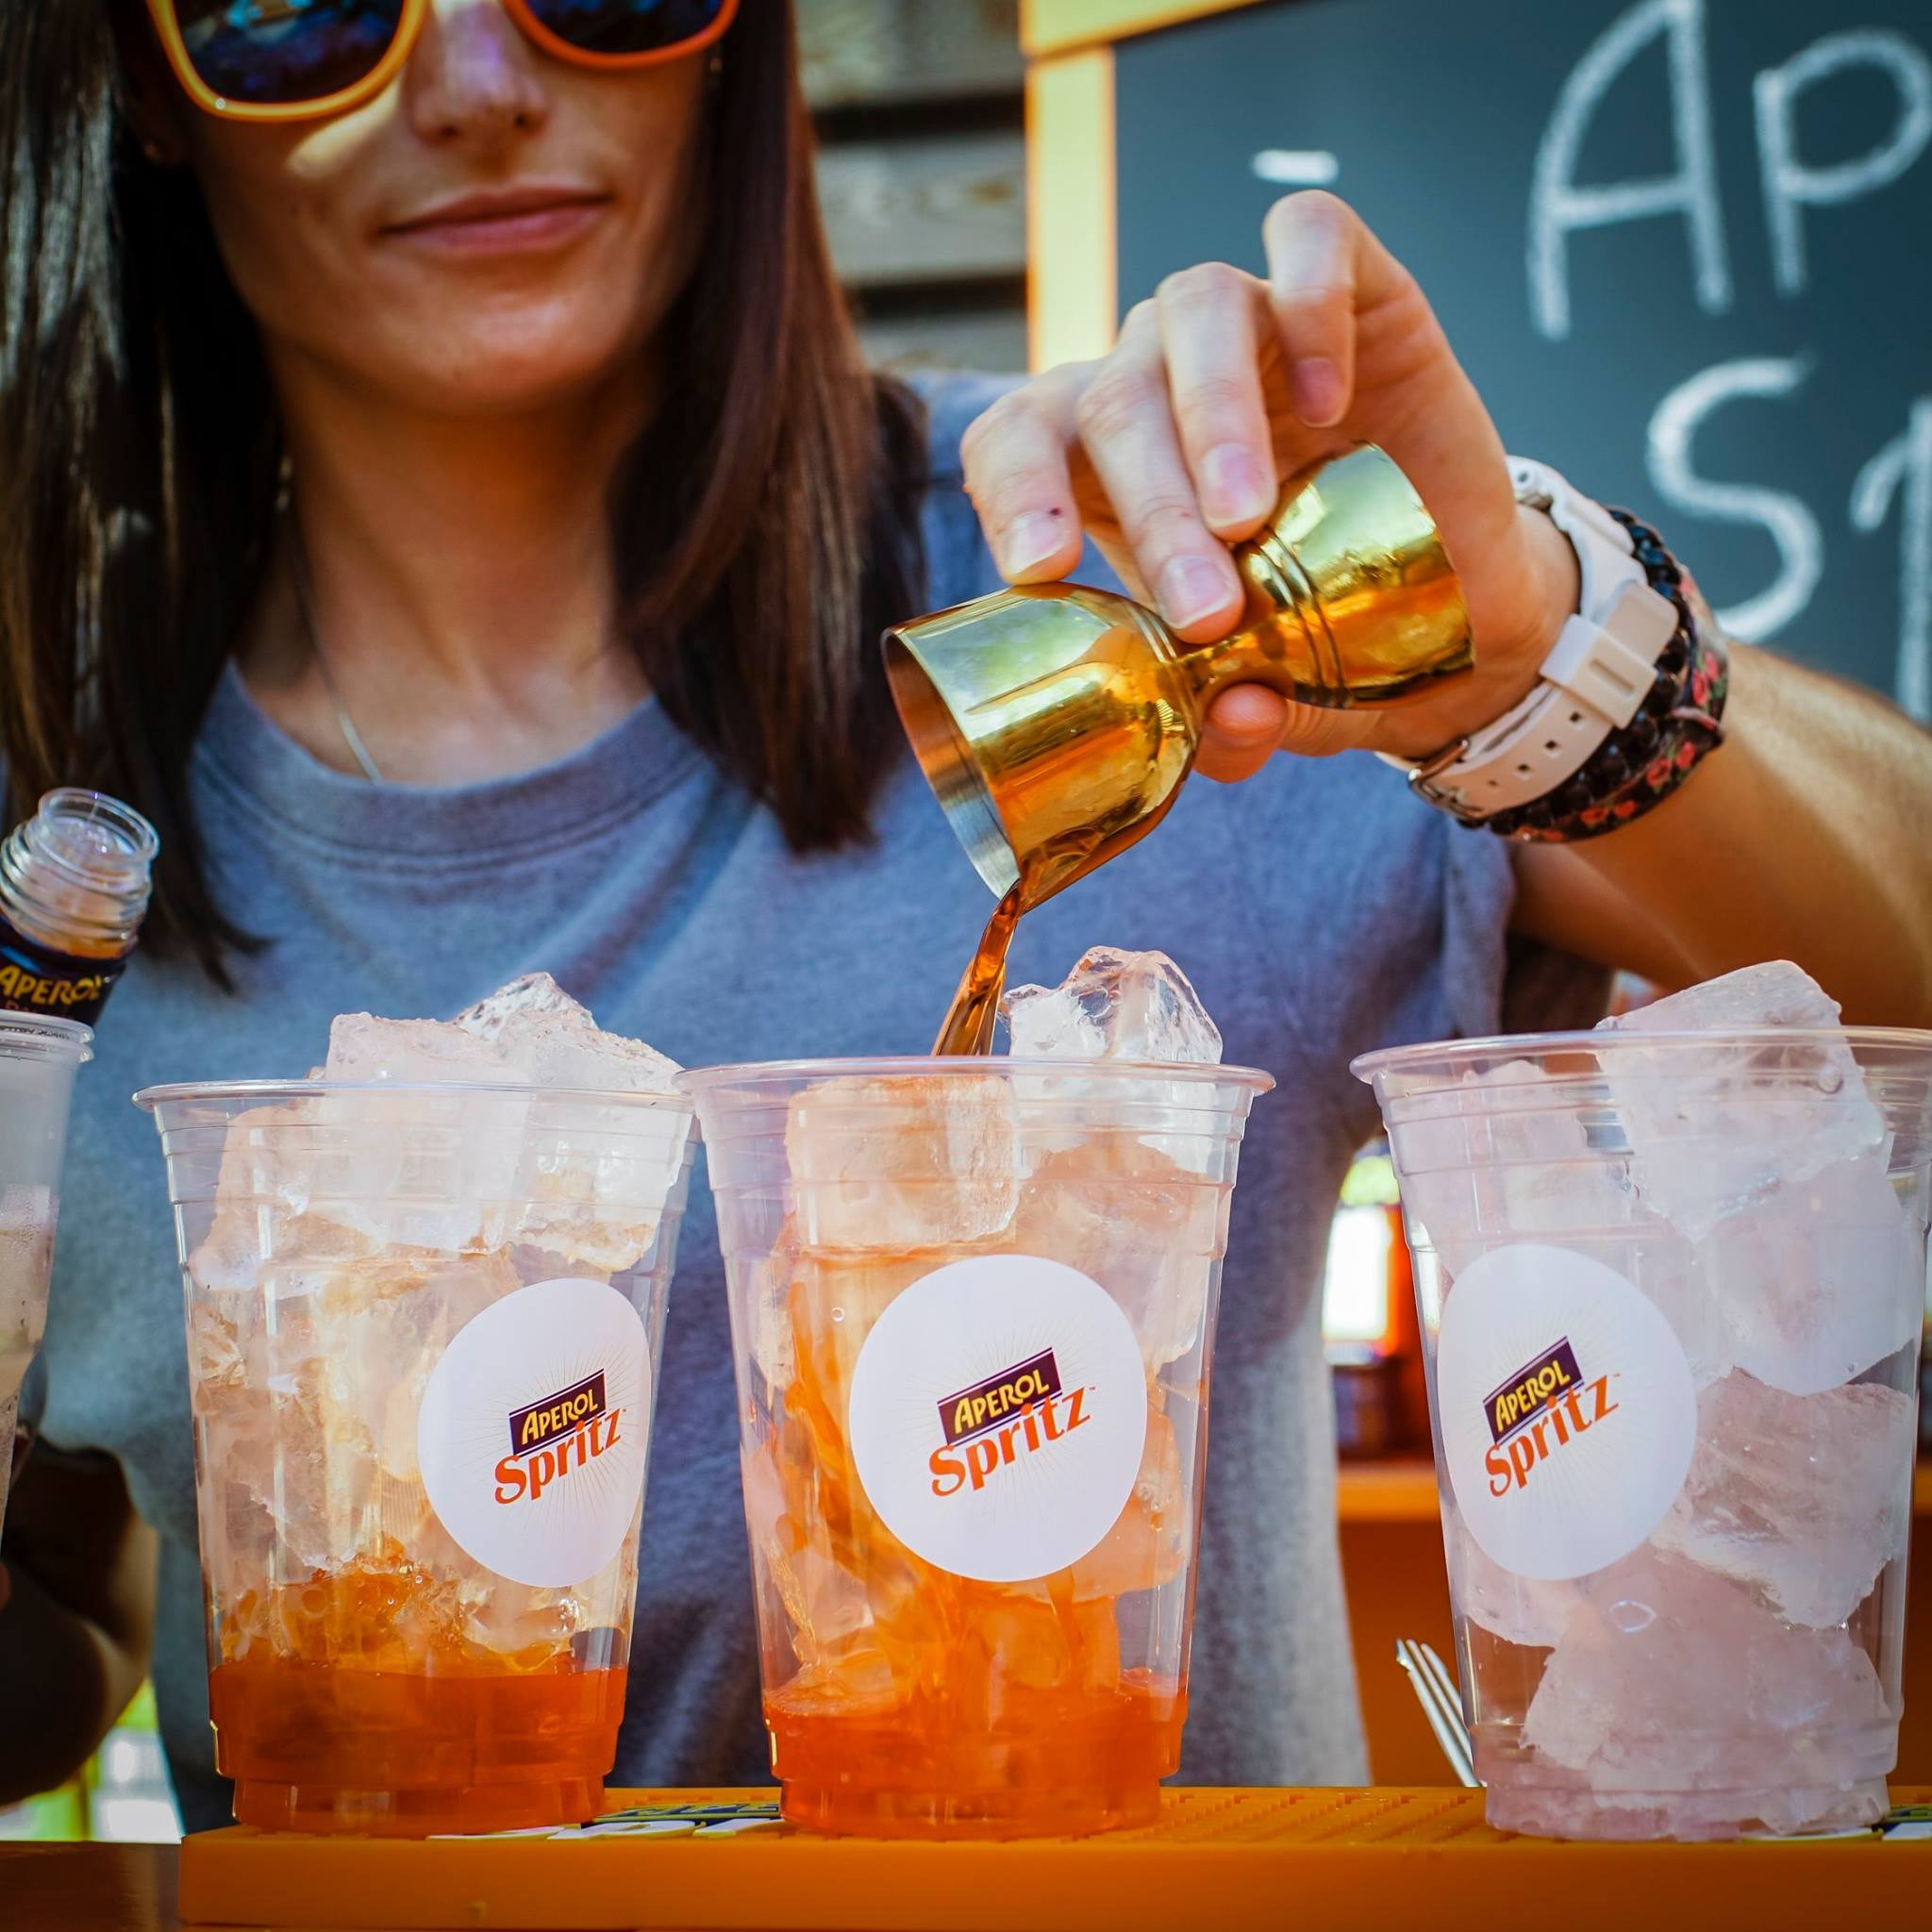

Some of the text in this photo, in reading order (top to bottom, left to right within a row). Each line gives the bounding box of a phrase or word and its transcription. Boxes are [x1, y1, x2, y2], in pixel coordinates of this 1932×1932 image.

[522, 1389, 598, 1445] APEROL
[954, 1369, 1050, 1435] APEROL
[1485, 1374, 1619, 1498] Spritz
[1495, 1360, 1571, 1433] APEROL
[494, 1408, 621, 1505] Spritz
[929, 1387, 1091, 1497] Spritz
